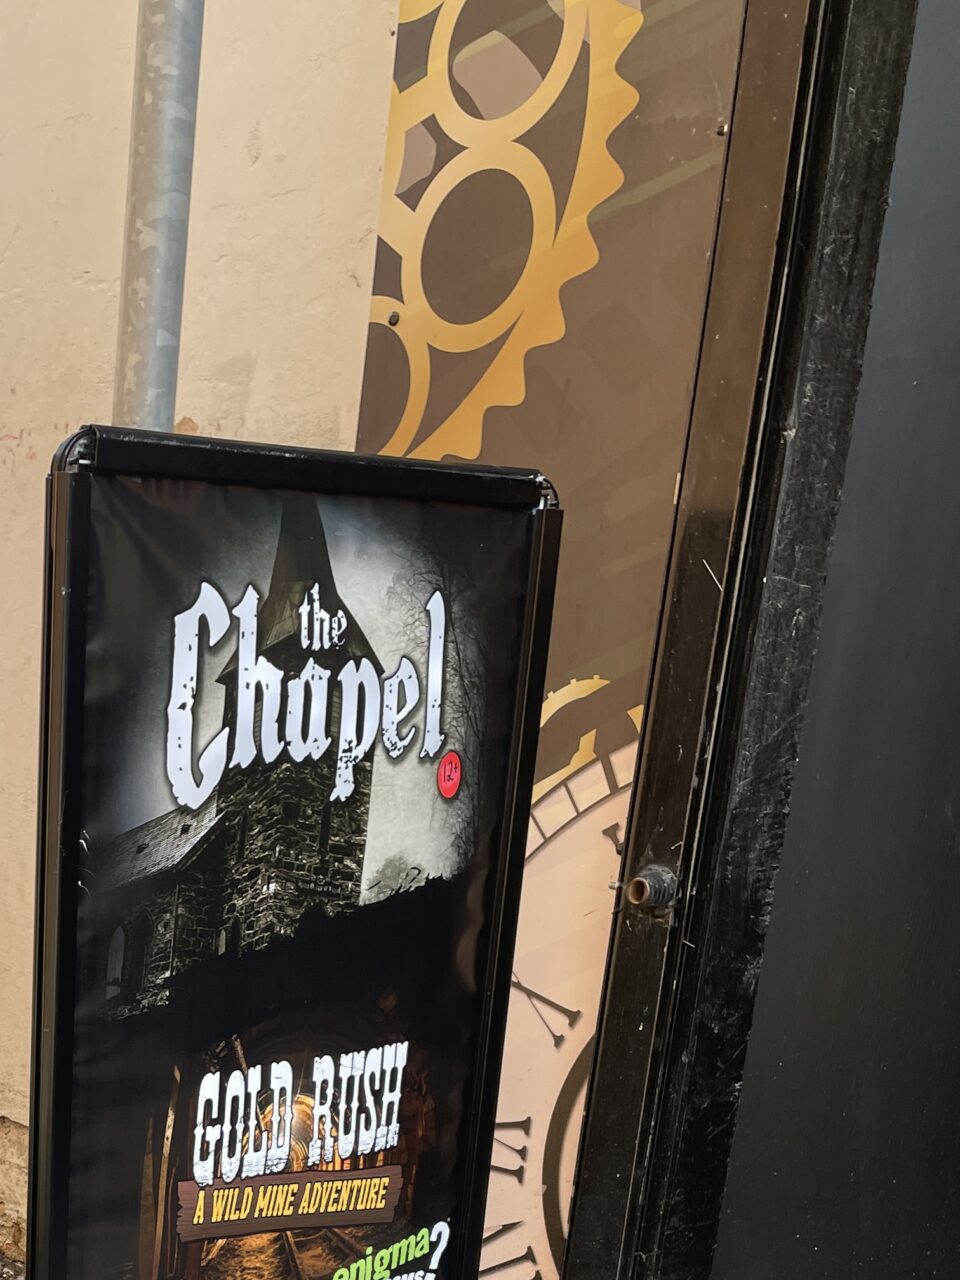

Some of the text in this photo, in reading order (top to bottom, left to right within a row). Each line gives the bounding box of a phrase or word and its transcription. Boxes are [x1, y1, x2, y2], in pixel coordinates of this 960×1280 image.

[298, 582, 347, 650] the
[166, 581, 445, 810] Chapel
[193, 1060, 294, 1188] GOLD
[307, 1041, 409, 1167] RUSH
[192, 1176, 390, 1225] A WILD MINE ADVENTURE
